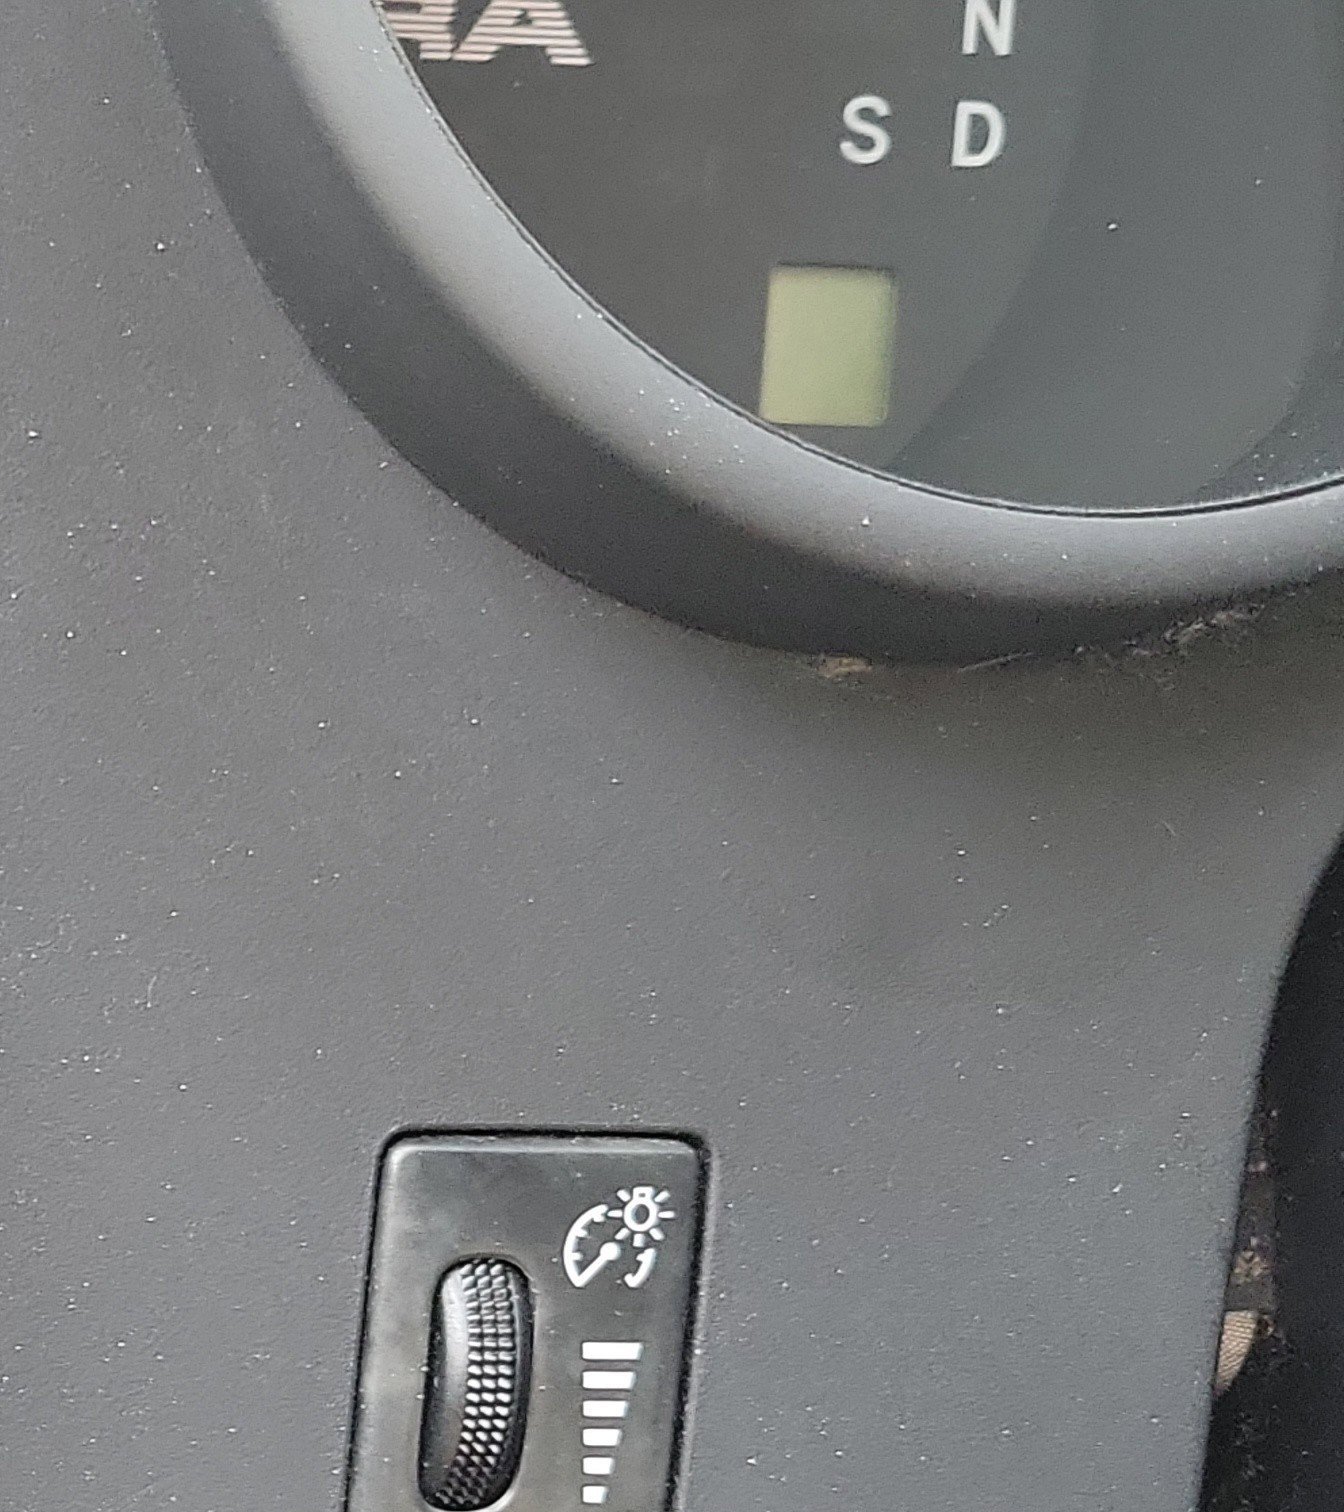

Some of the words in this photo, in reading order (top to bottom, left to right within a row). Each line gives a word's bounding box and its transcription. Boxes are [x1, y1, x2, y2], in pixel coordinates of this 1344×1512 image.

[962, 0, 1016, 55] N
[839, 95, 891, 164] S
[951, 101, 1005, 166] D
